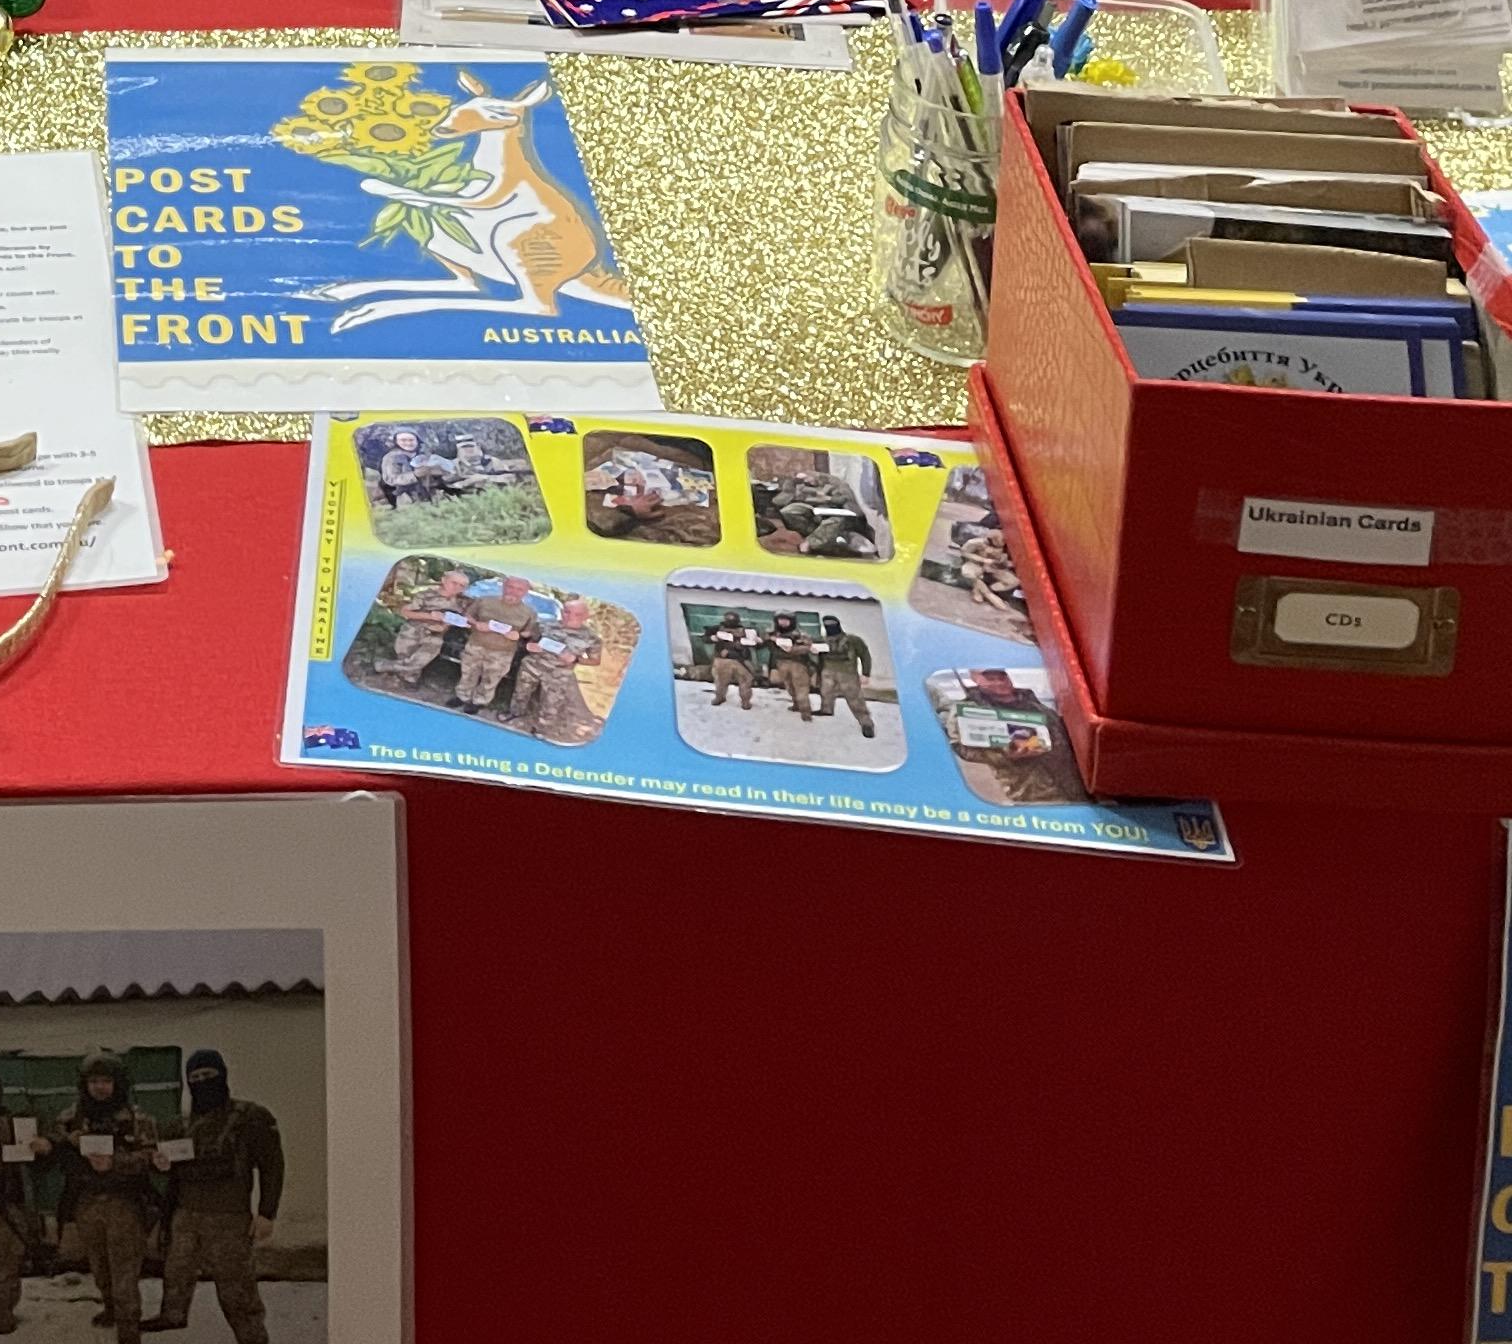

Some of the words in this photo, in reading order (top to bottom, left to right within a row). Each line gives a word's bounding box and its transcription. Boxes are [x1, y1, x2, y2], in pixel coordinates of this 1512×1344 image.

[115, 167, 251, 194] POST
[116, 205, 305, 234] CARDS
[114, 244, 183, 268] TO
[116, 277, 226, 301] THE
[123, 313, 310, 345] FRONT
[483, 326, 641, 346] AUSTRALIA
[1247, 505, 1352, 530] Ukrainian
[1357, 514, 1422, 534] Cards
[1324, 612, 1363, 629] CDs
[369, 744, 408, 760] The
[412, 747, 452, 763] last
[457, 752, 513, 773] thing
[517, 762, 529, 774] a
[535, 762, 635, 787] Defender
[641, 776, 687, 794] may
[692, 783, 742, 799] read
[747, 786, 767, 801] in
[772, 789, 825, 807] their
[829, 794, 865, 810] life
[870, 800, 918, 819] may
[923, 804, 951, 820] be
[958, 810, 970, 823] a
[976, 812, 1027, 829] card
[1032, 815, 1086, 835] from
[1093, 821, 1150, 843] YOU!
